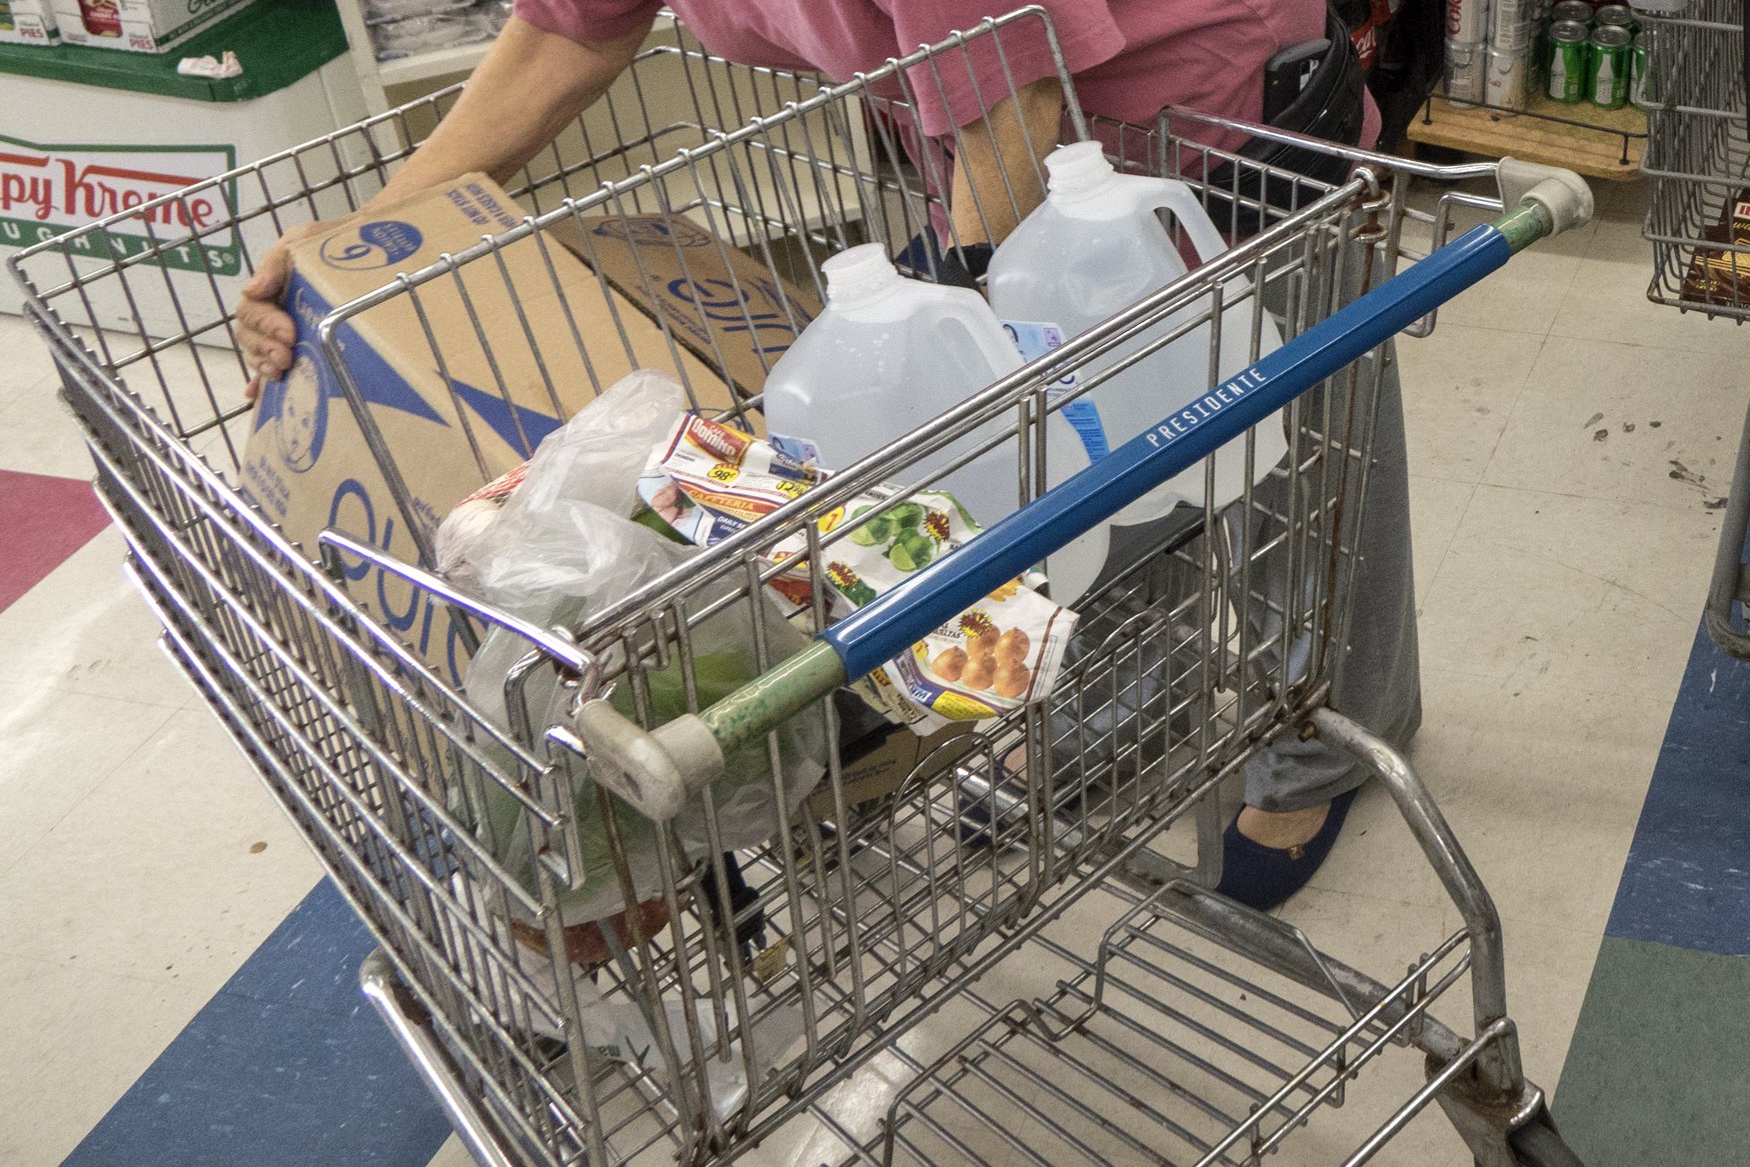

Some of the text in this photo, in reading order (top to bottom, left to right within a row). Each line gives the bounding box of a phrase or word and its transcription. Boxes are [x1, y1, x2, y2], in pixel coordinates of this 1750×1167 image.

[55, 158, 220, 227] Kreme
[1146, 368, 1266, 447] PRESIDENTE
[688, 489, 755, 511] CAFETERIA
[717, 515, 737, 528] DAILY
